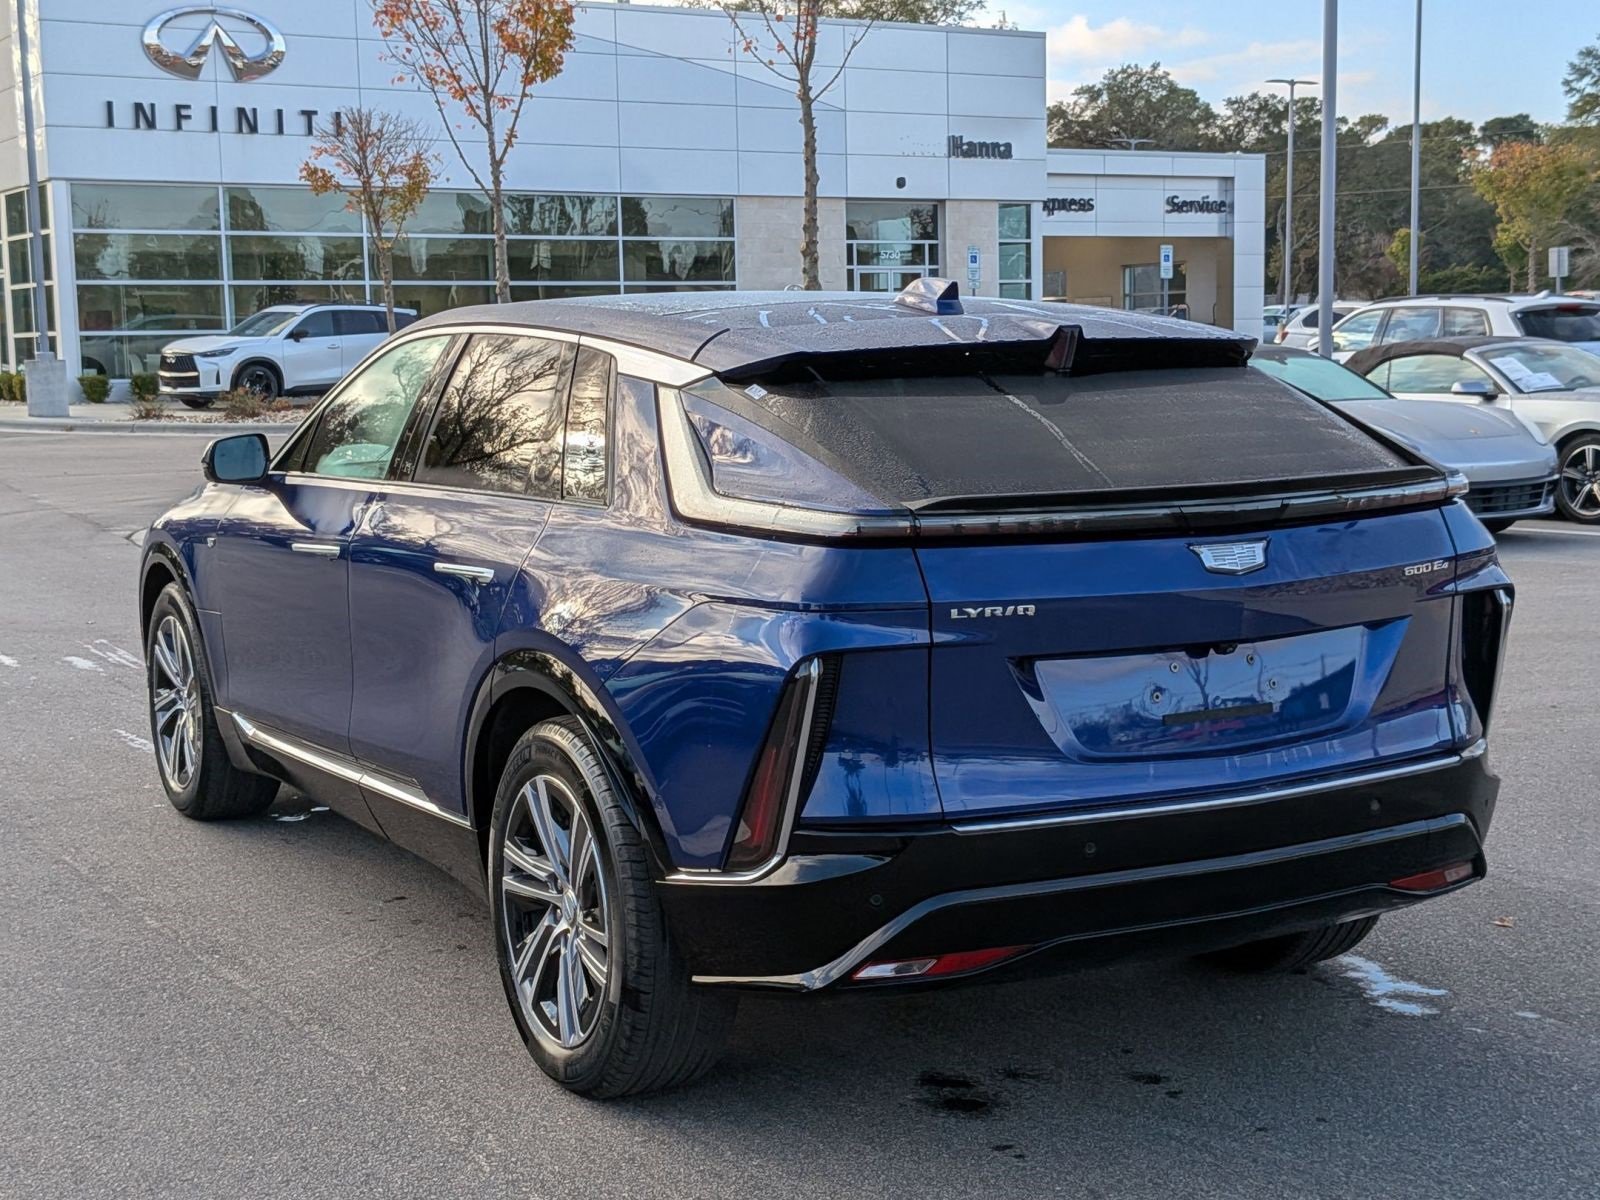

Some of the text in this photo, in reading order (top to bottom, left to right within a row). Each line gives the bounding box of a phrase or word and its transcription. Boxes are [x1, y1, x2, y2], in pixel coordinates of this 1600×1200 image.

[106, 100, 343, 138] INFINITI
[948, 135, 1013, 159] Hanna
[1165, 195, 1227, 214] Service
[880, 250, 901, 260] 5730
[1404, 562, 1432, 576] 600
[950, 604, 1036, 619] LYRIQ
